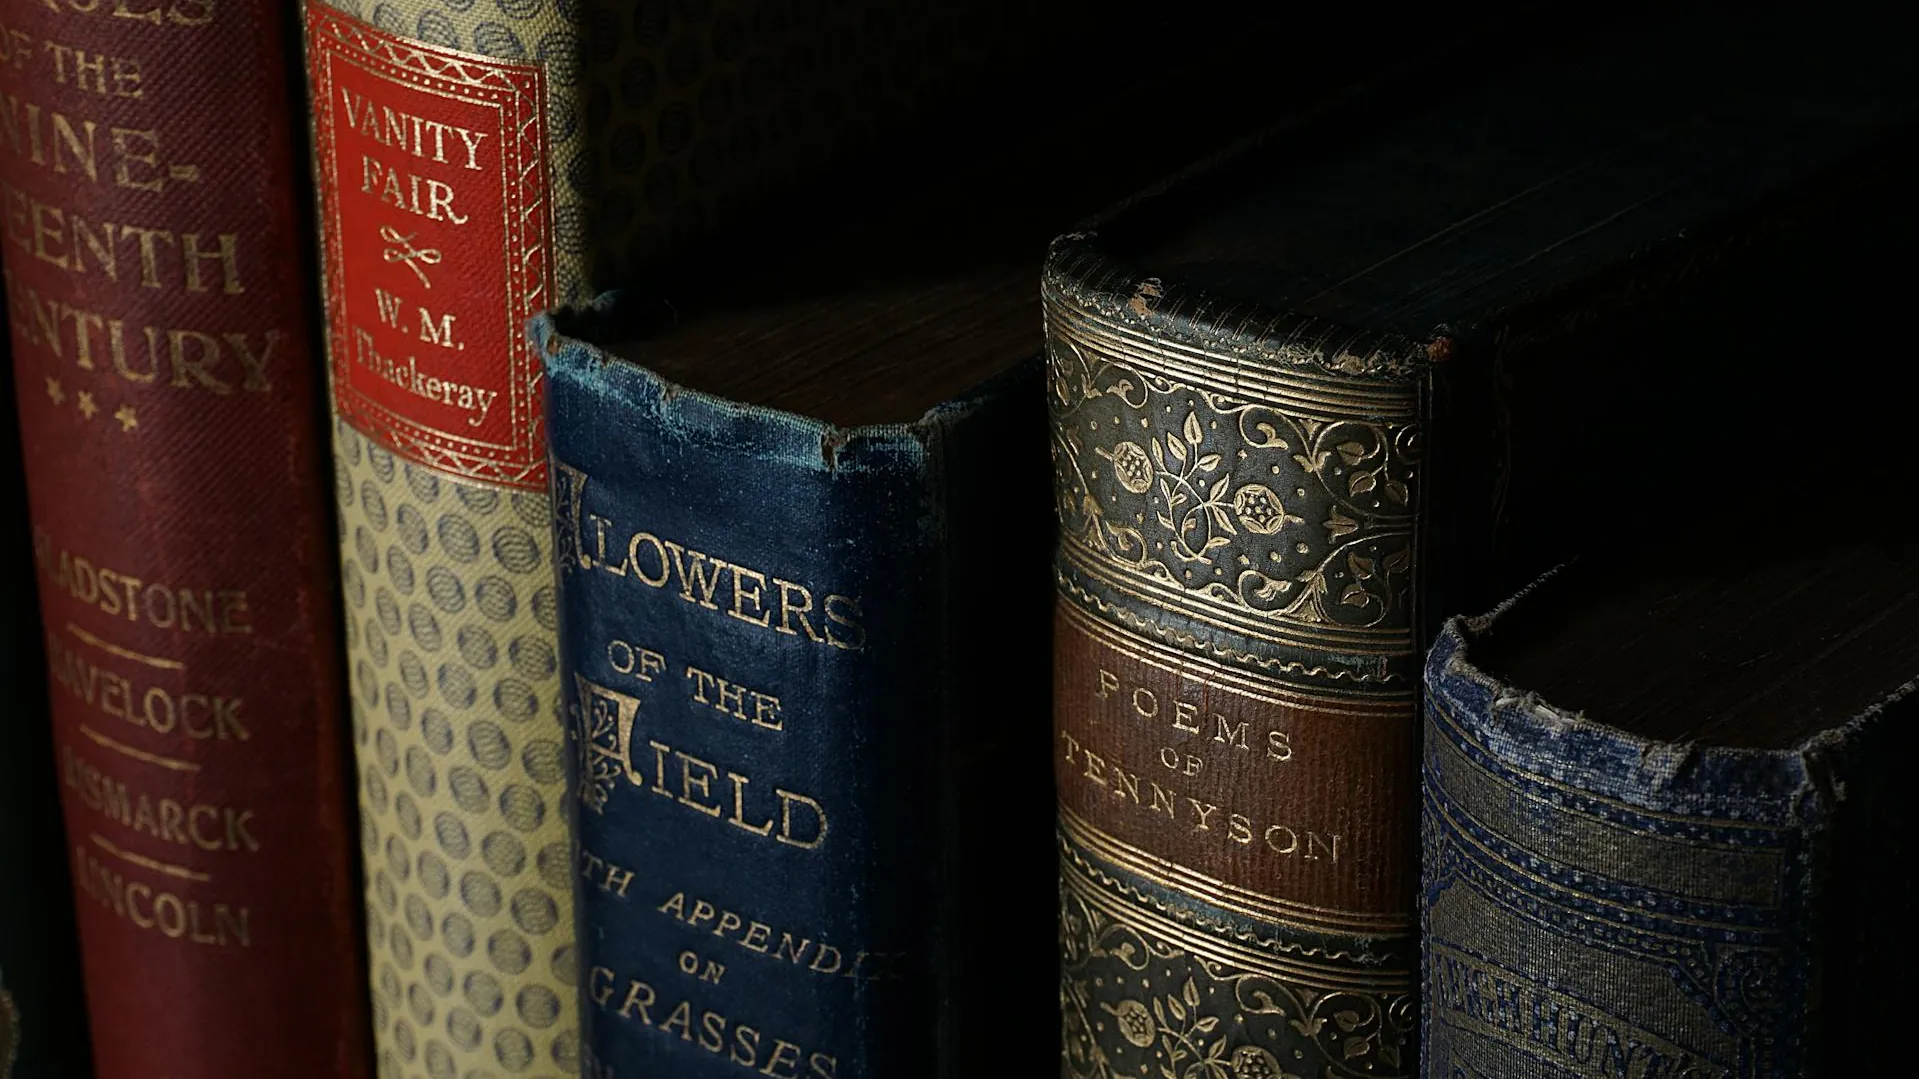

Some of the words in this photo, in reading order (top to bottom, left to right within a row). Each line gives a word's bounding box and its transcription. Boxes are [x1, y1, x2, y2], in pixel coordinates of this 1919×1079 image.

[45, 40, 143, 98] THE
[341, 86, 488, 170] VANITY
[360, 155, 469, 225] FAIR
[375, 288, 409, 334] W.
[418, 306, 465, 350] M.
[353, 326, 498, 427] Thackeray
[607, 640, 668, 683] OF
[686, 665, 784, 731] THE
[1097, 669, 1293, 762] POEMS
[1060, 730, 1342, 863] TENNYSON
[1160, 747, 1204, 777] OF
[678, 949, 727, 985] ON
[588, 965, 839, 1079] GRASSES
